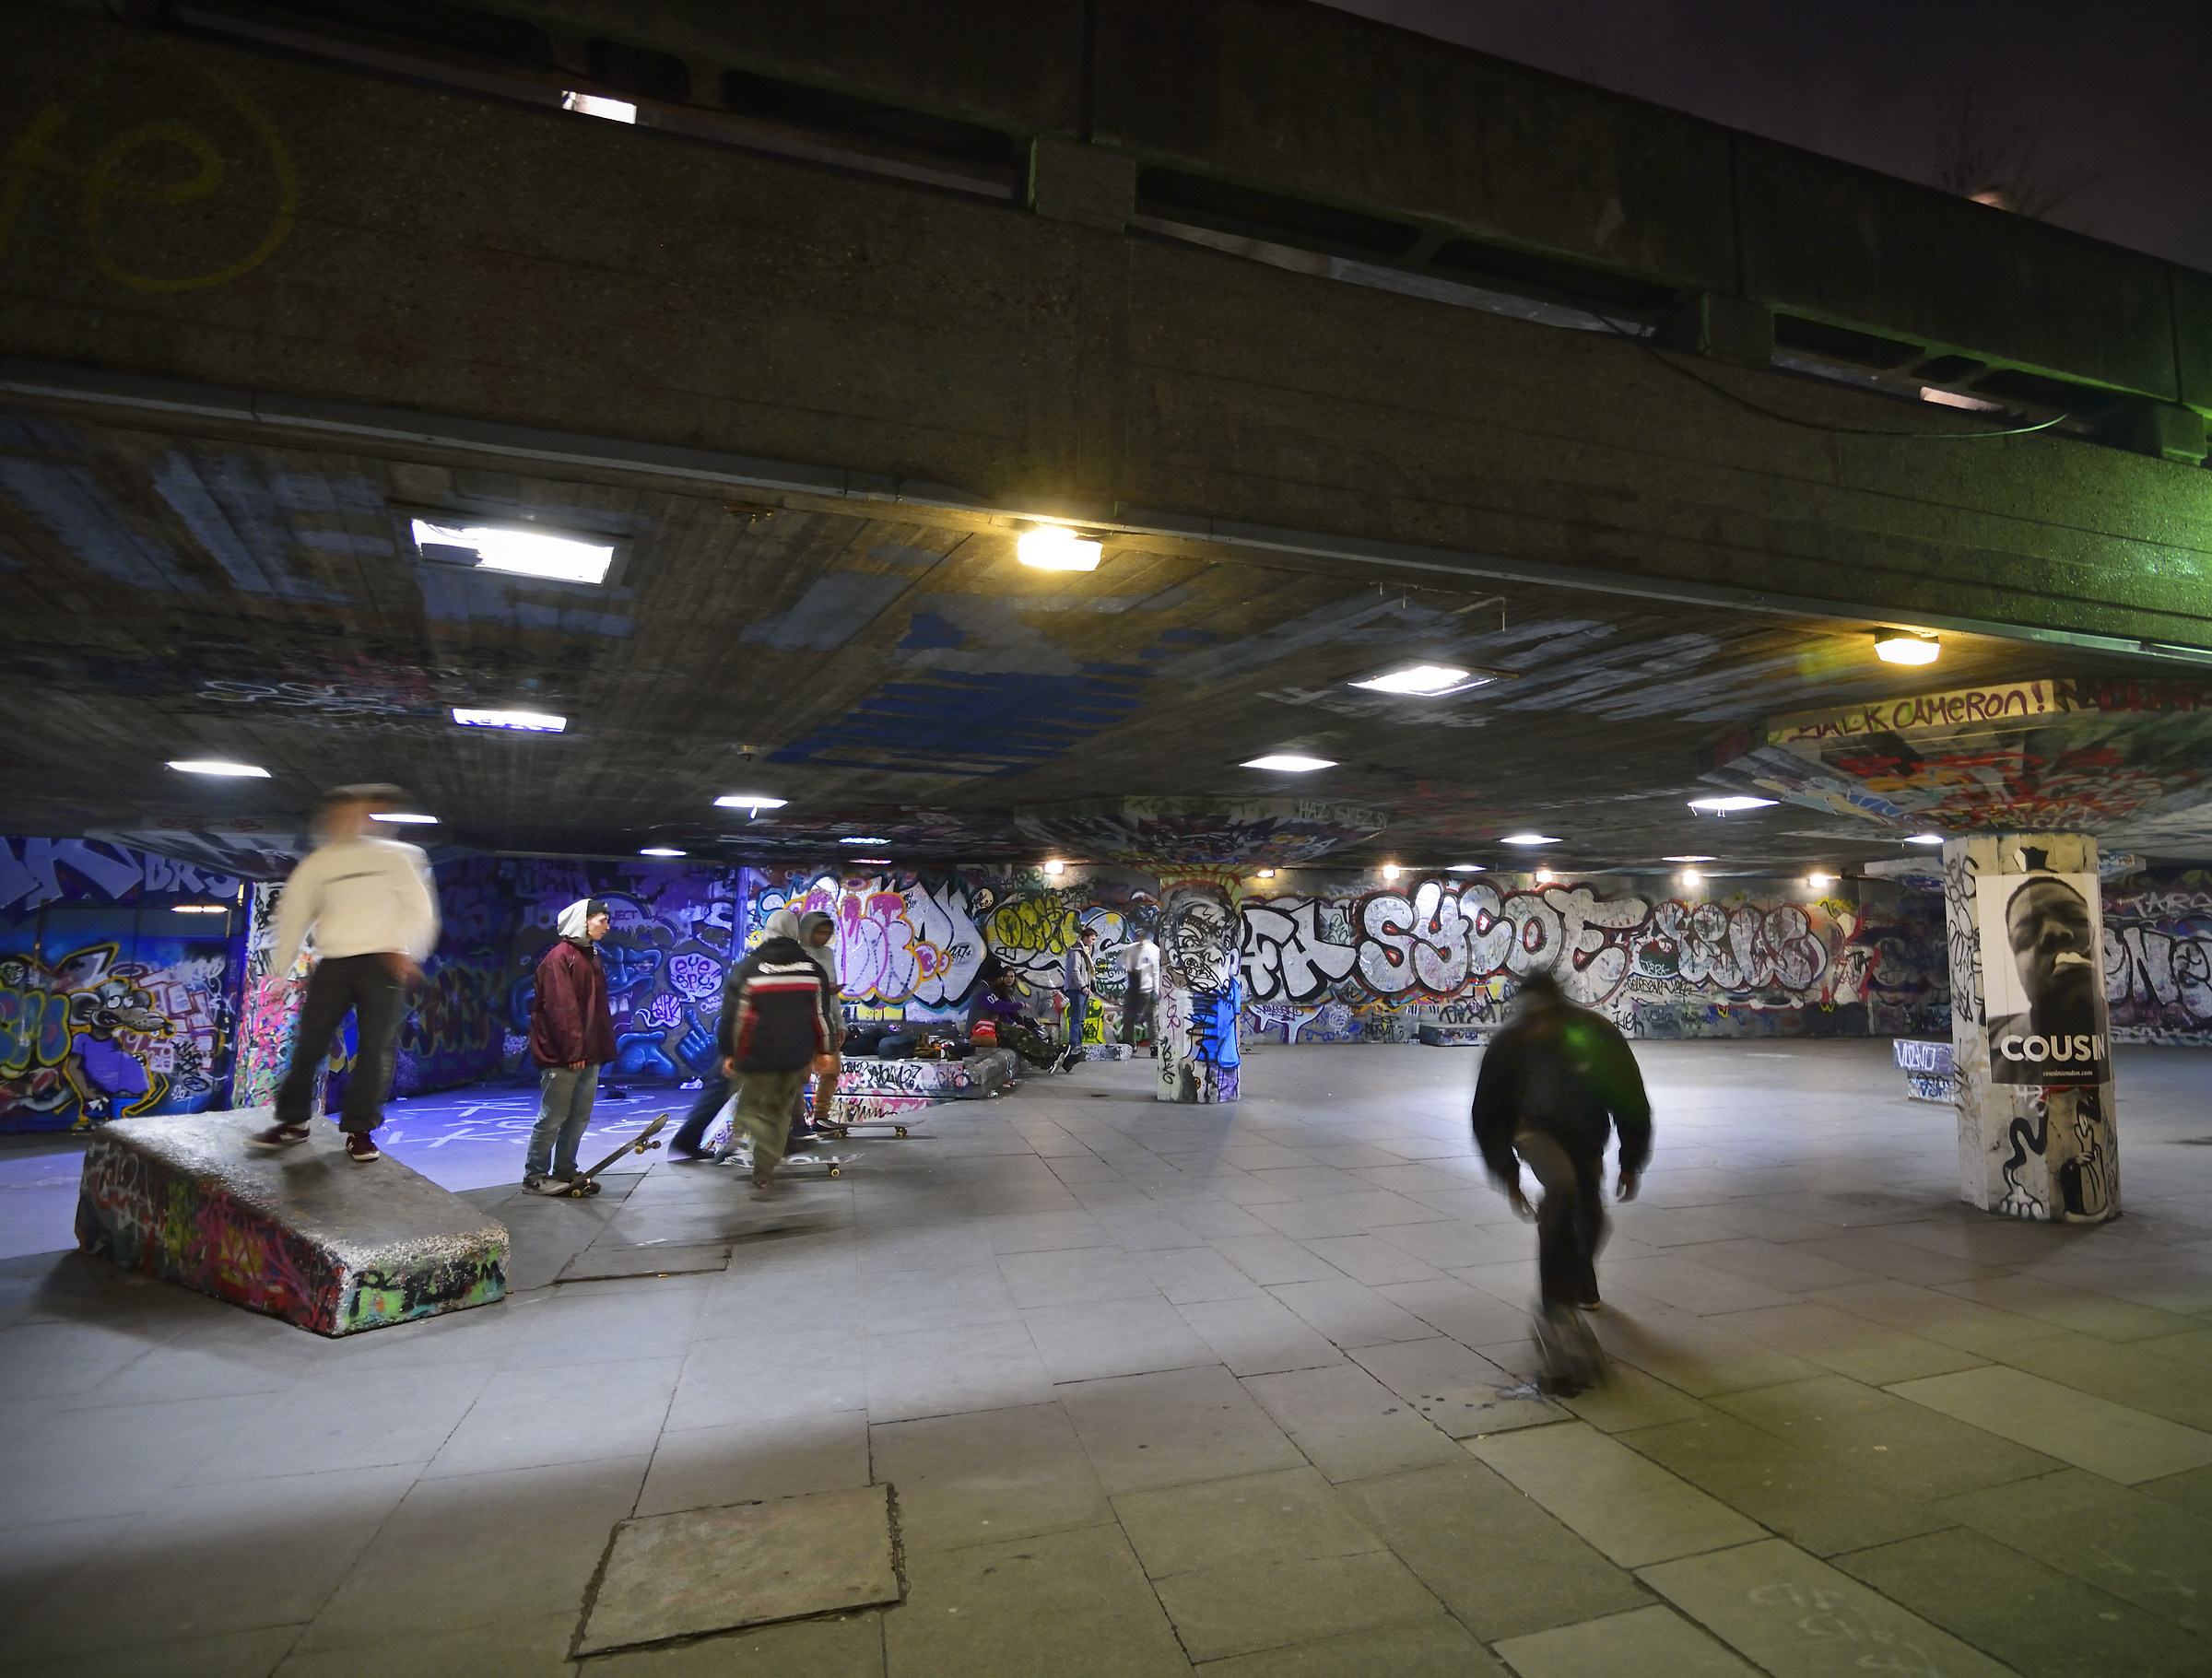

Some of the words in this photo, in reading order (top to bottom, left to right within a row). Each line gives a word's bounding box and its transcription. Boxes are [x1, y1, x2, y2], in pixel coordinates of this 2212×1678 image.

[1892, 683, 2045, 729] CAMERON!
[675, 955, 711, 975] eye
[987, 993, 999, 1004] 02
[2000, 1033, 2106, 1062] COUSIN
